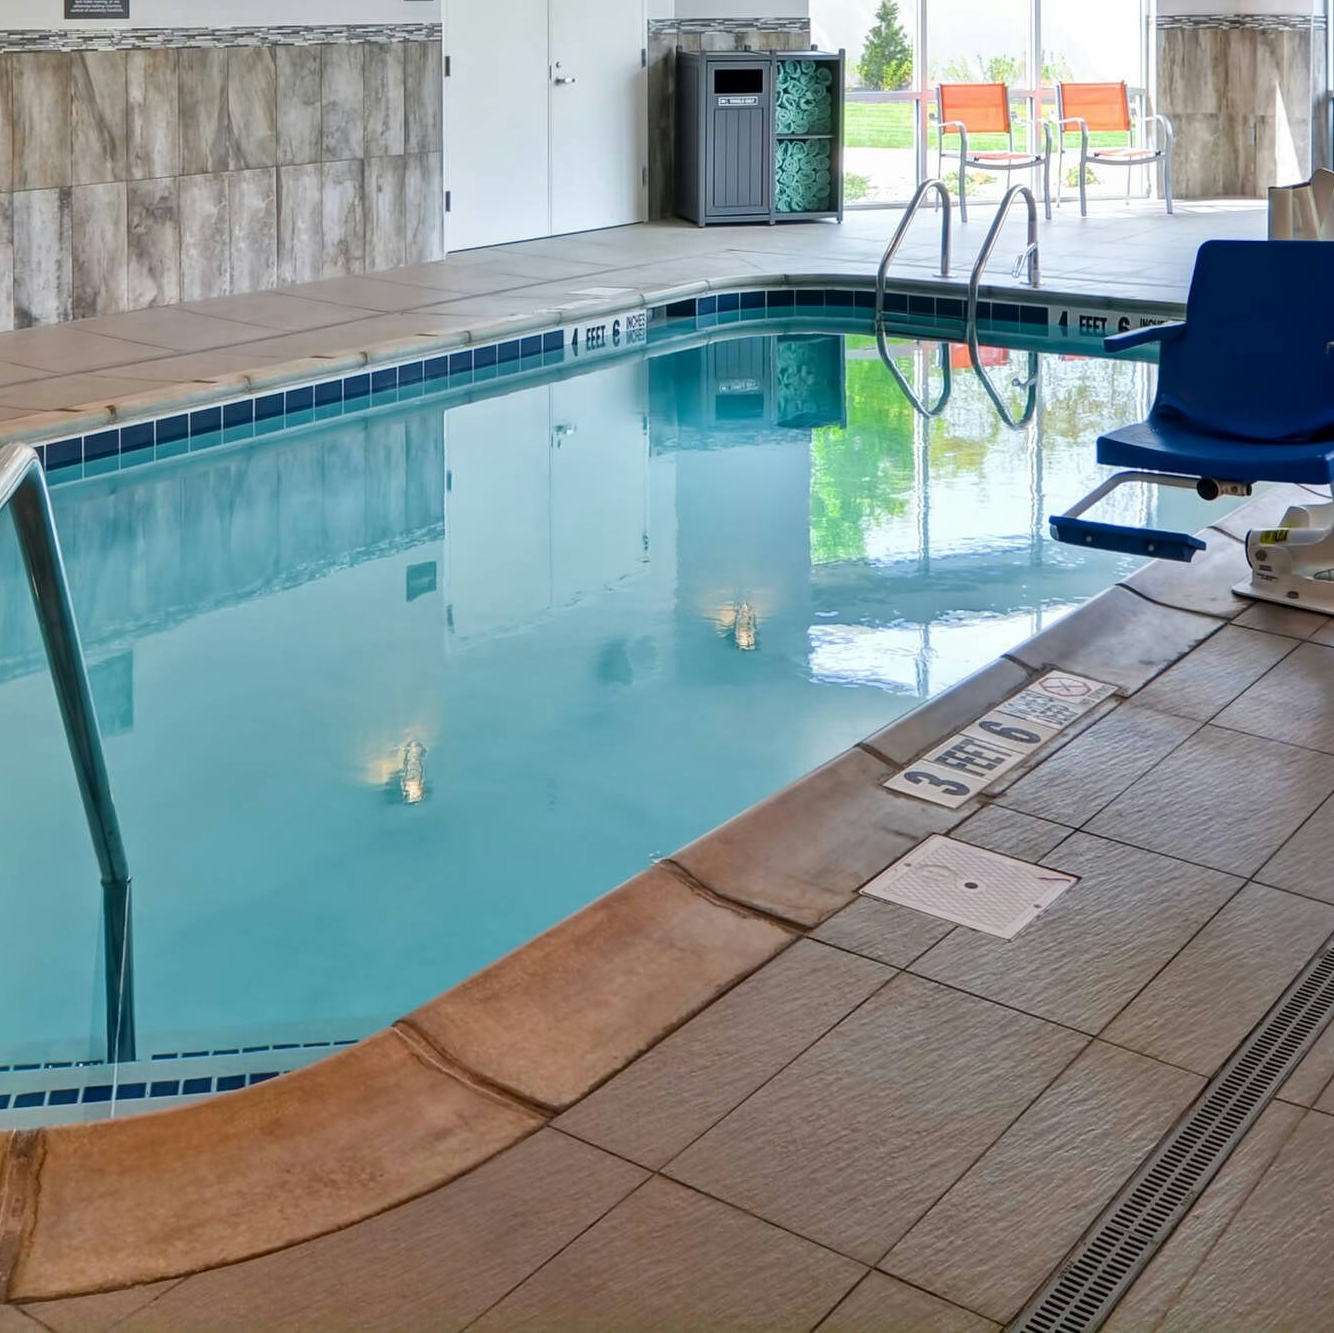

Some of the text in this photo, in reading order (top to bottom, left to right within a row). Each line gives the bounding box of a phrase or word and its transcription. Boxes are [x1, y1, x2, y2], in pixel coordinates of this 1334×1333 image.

[586, 325, 606, 342] FEET
[626, 313, 646, 330] INCHES
[1079, 315, 1107, 330] FEET
[1118, 316, 1131, 333] 6
[978, 720, 1042, 744] 6
[934, 736, 1012, 777] FEET
[903, 770, 971, 797] 3
